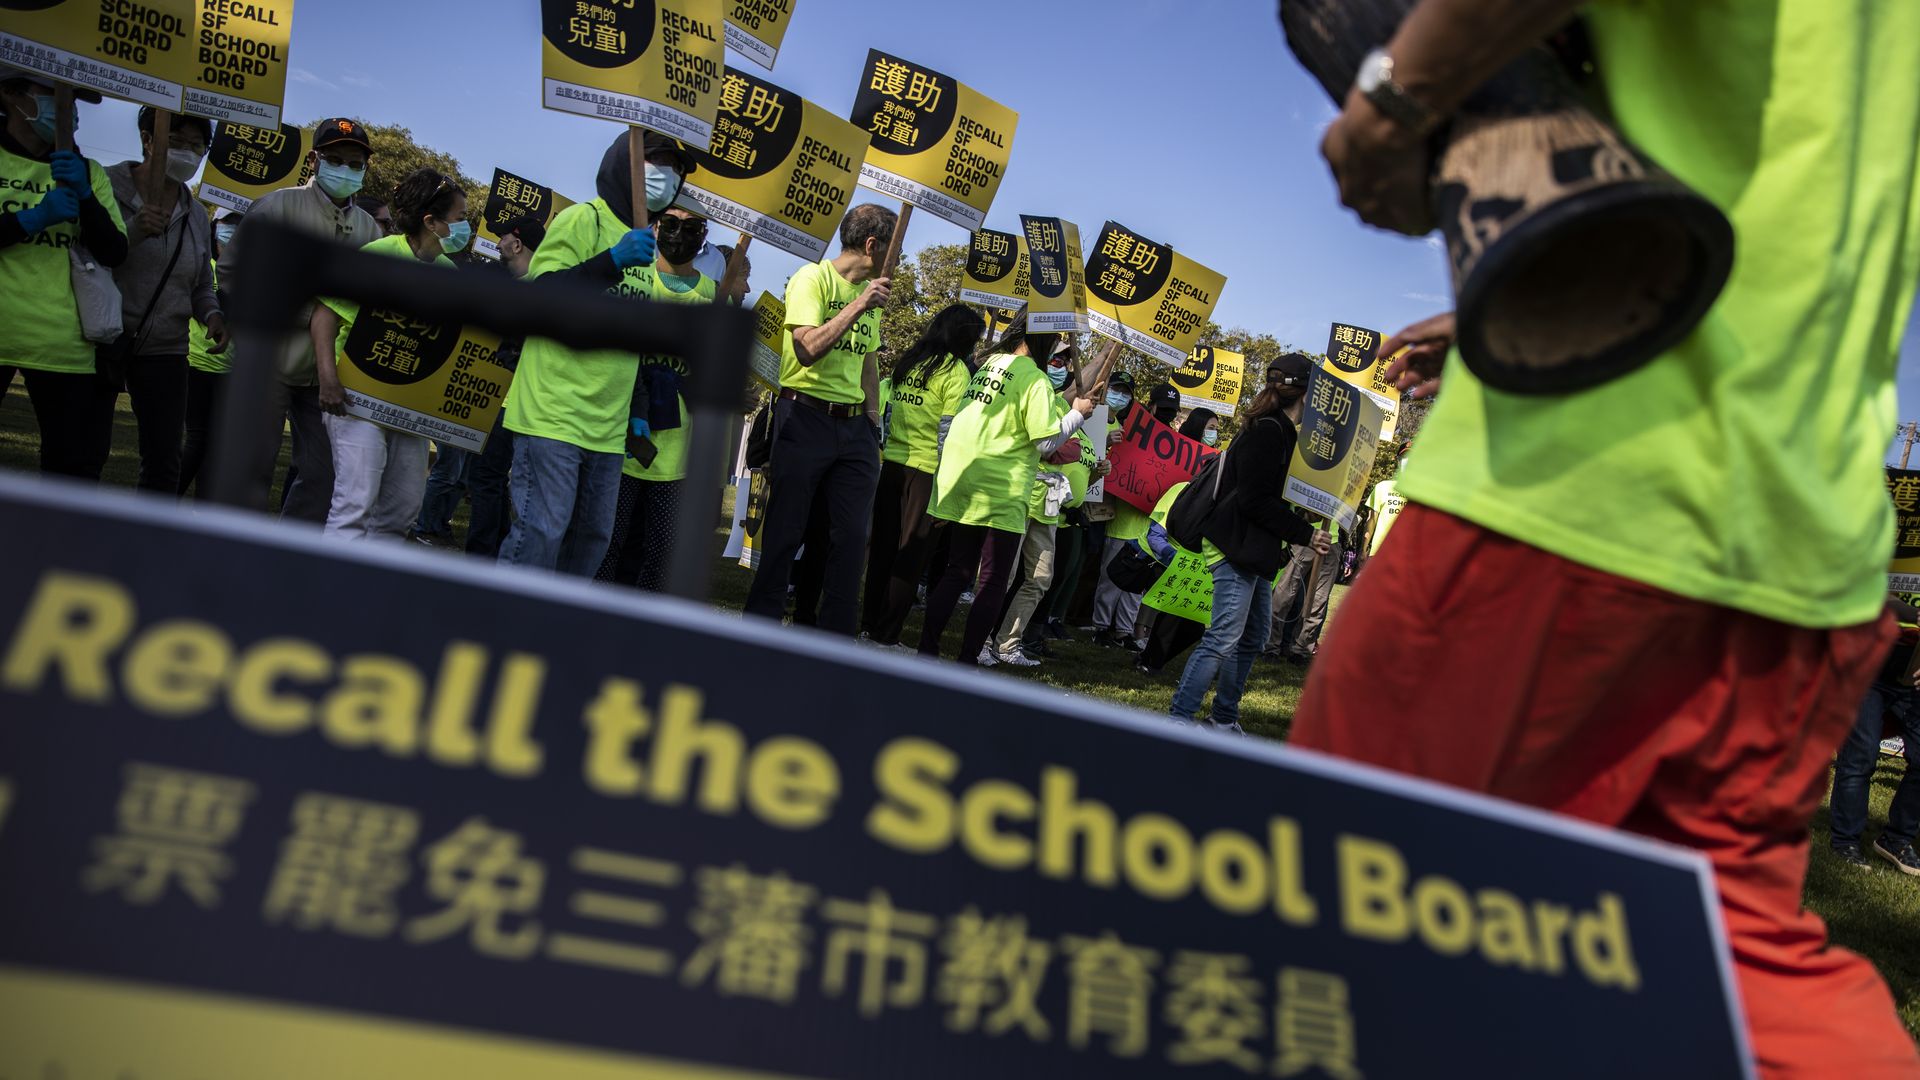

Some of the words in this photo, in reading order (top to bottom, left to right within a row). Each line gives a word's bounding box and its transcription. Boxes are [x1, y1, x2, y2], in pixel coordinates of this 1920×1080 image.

[101, 0, 186, 38] SCHOOL
[202, 11, 228, 30] SF
[203, 0, 279, 26] RECALL
[576, 1, 616, 24] 我們的
[730, 6, 761, 30] .ORG
[736, 0, 778, 22] OARD
[98, 14, 171, 51] BOARD
[568, 17, 627, 55] 兒童!
[661, 8, 717, 43] RECALL
[662, 27, 681, 47] SF
[96, 37, 148, 65] .ORG
[200, 29, 281, 63] SCHOOL
[198, 46, 268, 77] BOARD
[663, 45, 719, 80] SCHOOL
[77, 73, 131, 96] Sfethics.org
[197, 67, 245, 90] .ORG
[664, 63, 711, 94] BOARD
[870, 58, 942, 113] 護助
[665, 84, 697, 108] .ORG
[185, 101, 230, 119] fethics.org
[883, 100, 916, 123] 我們的
[717, 117, 754, 143] 我們的
[868, 112, 920, 147] 兒童!
[954, 130, 972, 147] SF
[957, 115, 1004, 149] RECALL
[237, 143, 265, 160] 我們的
[710, 129, 758, 171] 兒童!
[796, 152, 817, 172] SF
[801, 135, 852, 174] RECALL
[949, 144, 999, 178] SCHOOL
[225, 151, 269, 179] 兒童!
[945, 158, 989, 188] BOARD
[496, 174, 542, 211] 護助
[791, 168, 845, 206] SCHOOL
[940, 175, 971, 197] .ORG
[784, 183, 834, 217] BOARD
[779, 201, 814, 226] .ORG
[974, 231, 1009, 257] 護助
[1026, 220, 1060, 253] 護助
[1101, 229, 1160, 275] 護助
[622, 267, 646, 282] CALL
[1014, 278, 1030, 288] BOA
[1016, 269, 1031, 280] SCH
[1109, 262, 1135, 281] 我們的
[1011, 287, 1030, 297] .ORG
[1096, 271, 1137, 300] 兒童!
[1164, 288, 1181, 302] SF
[1170, 277, 1209, 305] RECALL
[759, 305, 783, 327] RECALL
[865, 310, 875, 320] HE
[1154, 310, 1192, 335] BOARD
[1160, 300, 1202, 328] SCHOOL
[383, 329, 419, 351] 我們的
[1149, 323, 1177, 341] .ORG
[1335, 325, 1373, 351] 護助
[366, 341, 421, 376] 兒童!
[833, 339, 868, 355] OARD
[1187, 347, 1209, 363] LP
[455, 354, 475, 371] SF
[1216, 363, 1239, 374] RECALL
[1336, 351, 1362, 369] 兒童!
[450, 369, 502, 399] SCHOOL
[970, 377, 1006, 396] CHOOL
[998, 367, 1015, 381] THE
[1214, 377, 1239, 389] SCHOOL
[444, 383, 490, 409] BOARD
[1210, 392, 1227, 401] .ORG
[1212, 384, 1235, 395] BOARD
[1310, 374, 1353, 426] 護助
[1371, 382, 1387, 393] .ORG
[438, 400, 472, 420] .ORG
[1306, 430, 1337, 461] 兒童!
[1105, 450, 1145, 496] Better
[1, 570, 548, 777] Recall
[583, 676, 842, 829] the
[866, 737, 1319, 928] School
[1337, 834, 1642, 993] Board
